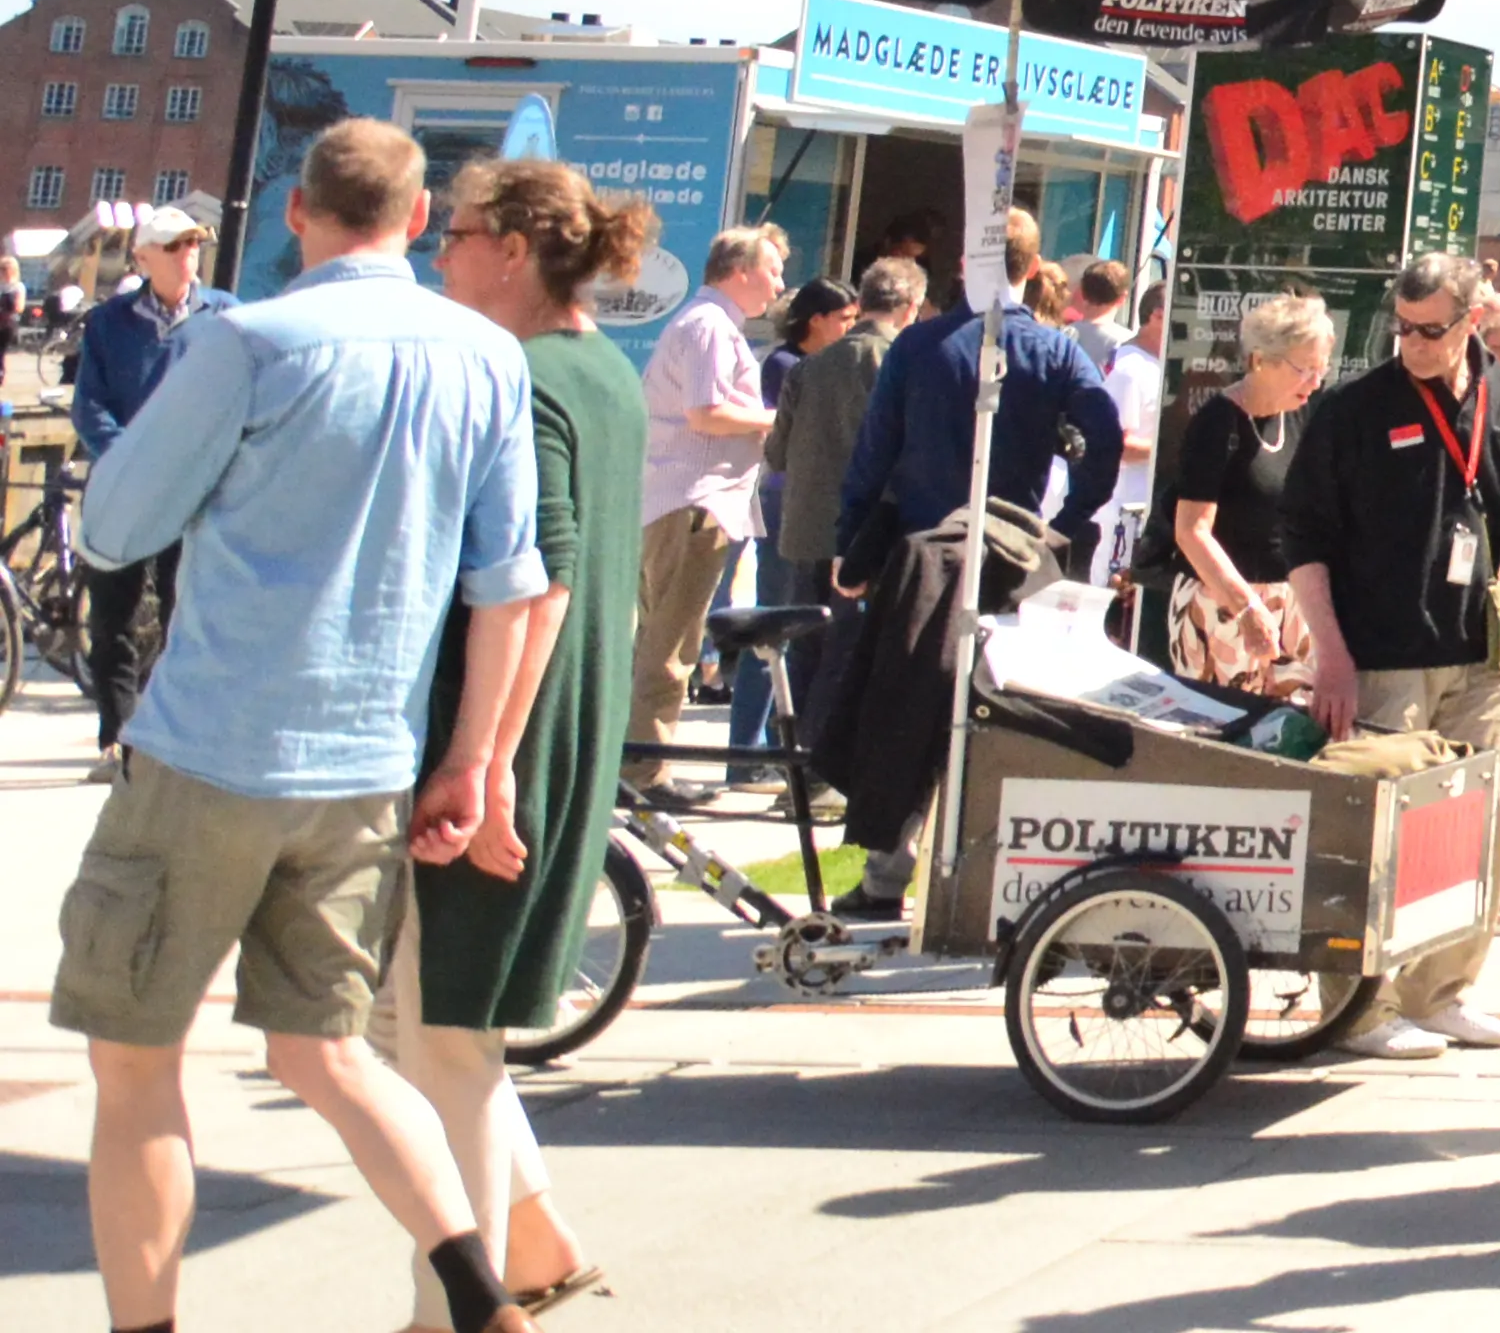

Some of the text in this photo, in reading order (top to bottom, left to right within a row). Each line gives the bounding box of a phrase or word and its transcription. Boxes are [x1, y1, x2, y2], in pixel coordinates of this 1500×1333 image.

[1094, 14, 1248, 42] den levende avis
[812, 21, 1134, 110] MADGLÆDE ER IVSGLÆDE
[1429, 57, 1438, 85] A
[1425, 104, 1434, 132] B
[1456, 110, 1466, 139] E
[1201, 61, 1410, 225] DAC
[1328, 167, 1390, 185] DANSK
[1421, 151, 1430, 179] C
[1453, 156, 1462, 183] F
[1271, 189, 1389, 209] ARKITEKTUR
[1313, 213, 1386, 232] CENTER
[1449, 202, 1458, 231] G
[1008, 817, 1297, 860] POLITIKEN
[1002, 872, 1054, 903] de
[1223, 882, 1293, 913] avis
